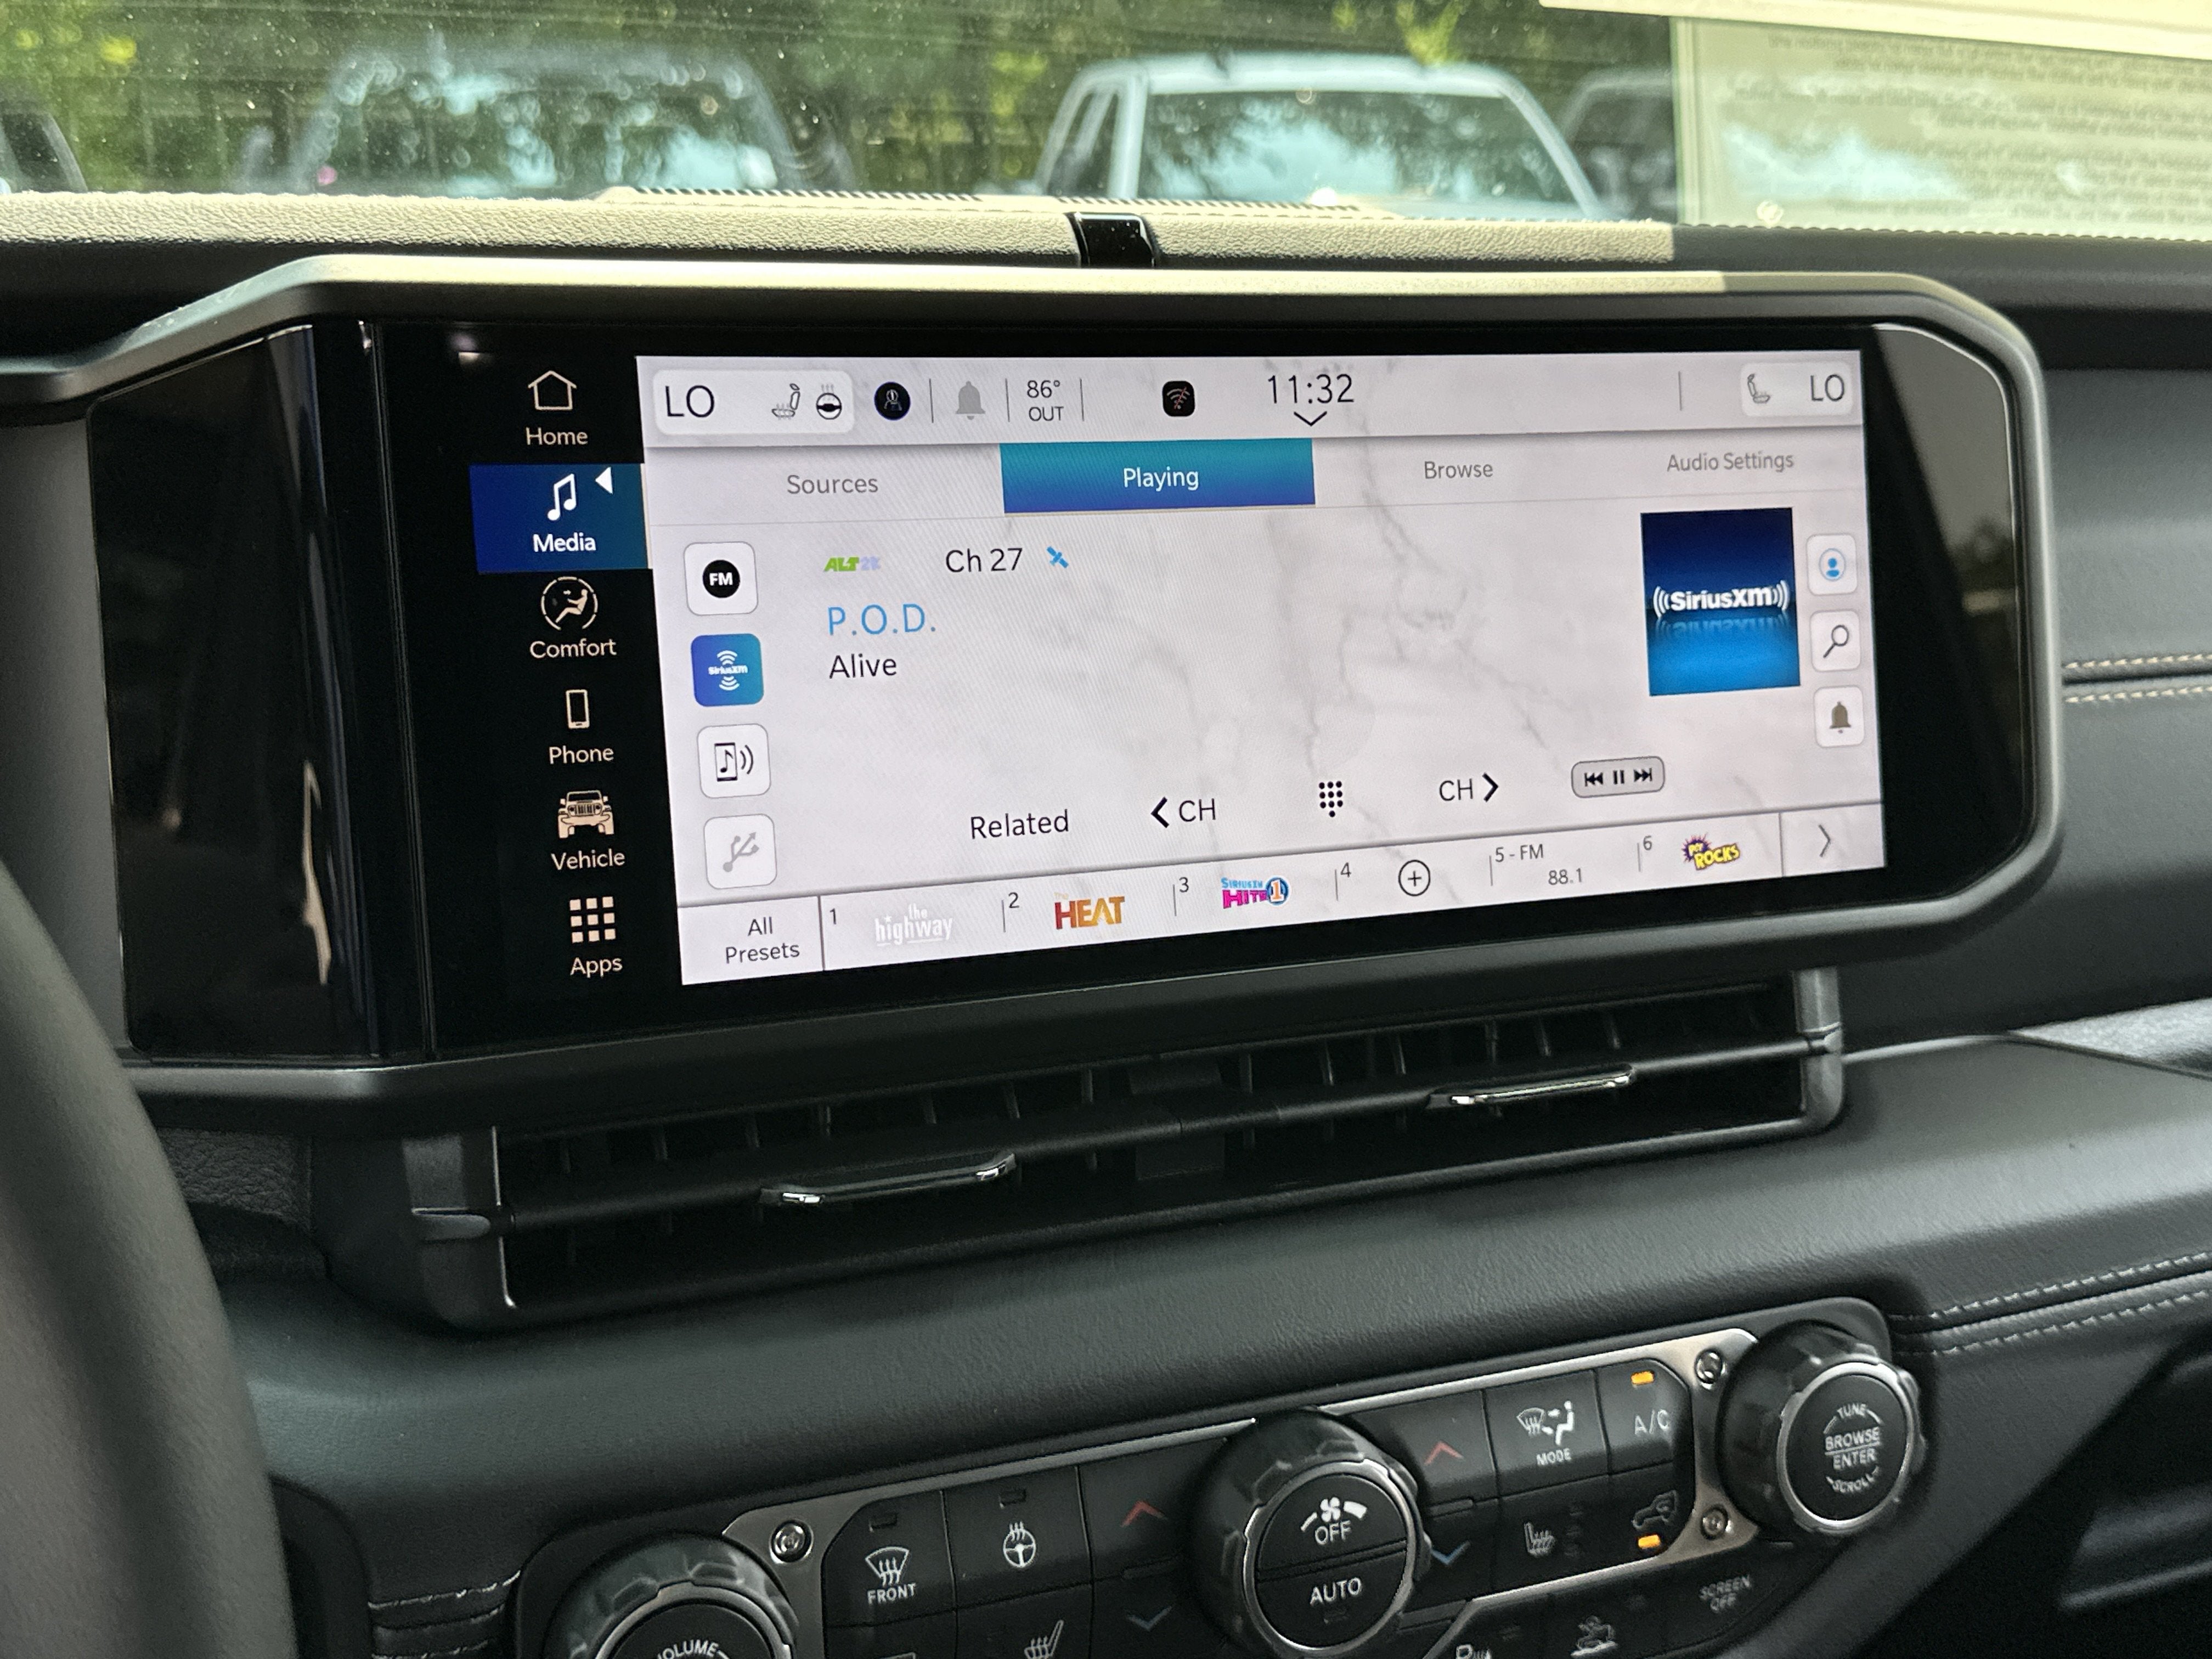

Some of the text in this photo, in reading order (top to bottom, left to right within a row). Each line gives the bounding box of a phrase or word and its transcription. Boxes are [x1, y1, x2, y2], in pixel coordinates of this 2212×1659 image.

[1026, 380, 1060, 398] 86°
[1268, 373, 1354, 404] 11:32
[1810, 374, 1846, 402] LO
[665, 385, 715, 418] LO
[1028, 406, 1064, 422] OUT
[526, 427, 588, 445] Home
[1424, 461, 1493, 479] Browse
[1667, 451, 1795, 473] Audio Settings
[787, 474, 878, 494] Sources
[1123, 466, 1199, 492] Playing
[533, 532, 596, 552] Media
[945, 548, 1023, 573] Ch 27
[708, 571, 735, 588] FM
[828, 603, 935, 636] P.O.D.
[529, 637, 617, 659] Comfort
[829, 653, 896, 679] Alive
[549, 745, 614, 764] Phone
[1439, 778, 1474, 802] CH
[1178, 798, 1216, 822] CH
[970, 809, 1069, 839] Related
[1495, 847, 1505, 863] 5
[1520, 843, 1544, 860] FM
[1643, 835, 1652, 851] 6
[551, 848, 625, 870] Vehicle
[1694, 844, 1740, 870] ROCKS
[1340, 862, 1351, 878] 4
[1548, 867, 1582, 885] 88.1
[1179, 876, 1189, 893] 3
[908, 903, 928, 918] the
[1008, 891, 1019, 909] 2
[830, 908, 837, 925] 1
[1054, 896, 1125, 930] HEAT
[748, 916, 773, 936] All
[874, 916, 952, 945] highway
[725, 943, 800, 964] Presets
[570, 957, 623, 978] Apps
[1635, 1409, 1669, 1434] A/C
[1837, 1403, 1866, 1419] TUNE
[1825, 1426, 1880, 1451] BROWSE
[1536, 1448, 1572, 1465] MODE
[1833, 1448, 1877, 1470] ENTER
[1314, 1522, 1350, 1545] OFF
[867, 1583, 916, 1604] FRONT
[1310, 1577, 1362, 1604] AUTO
